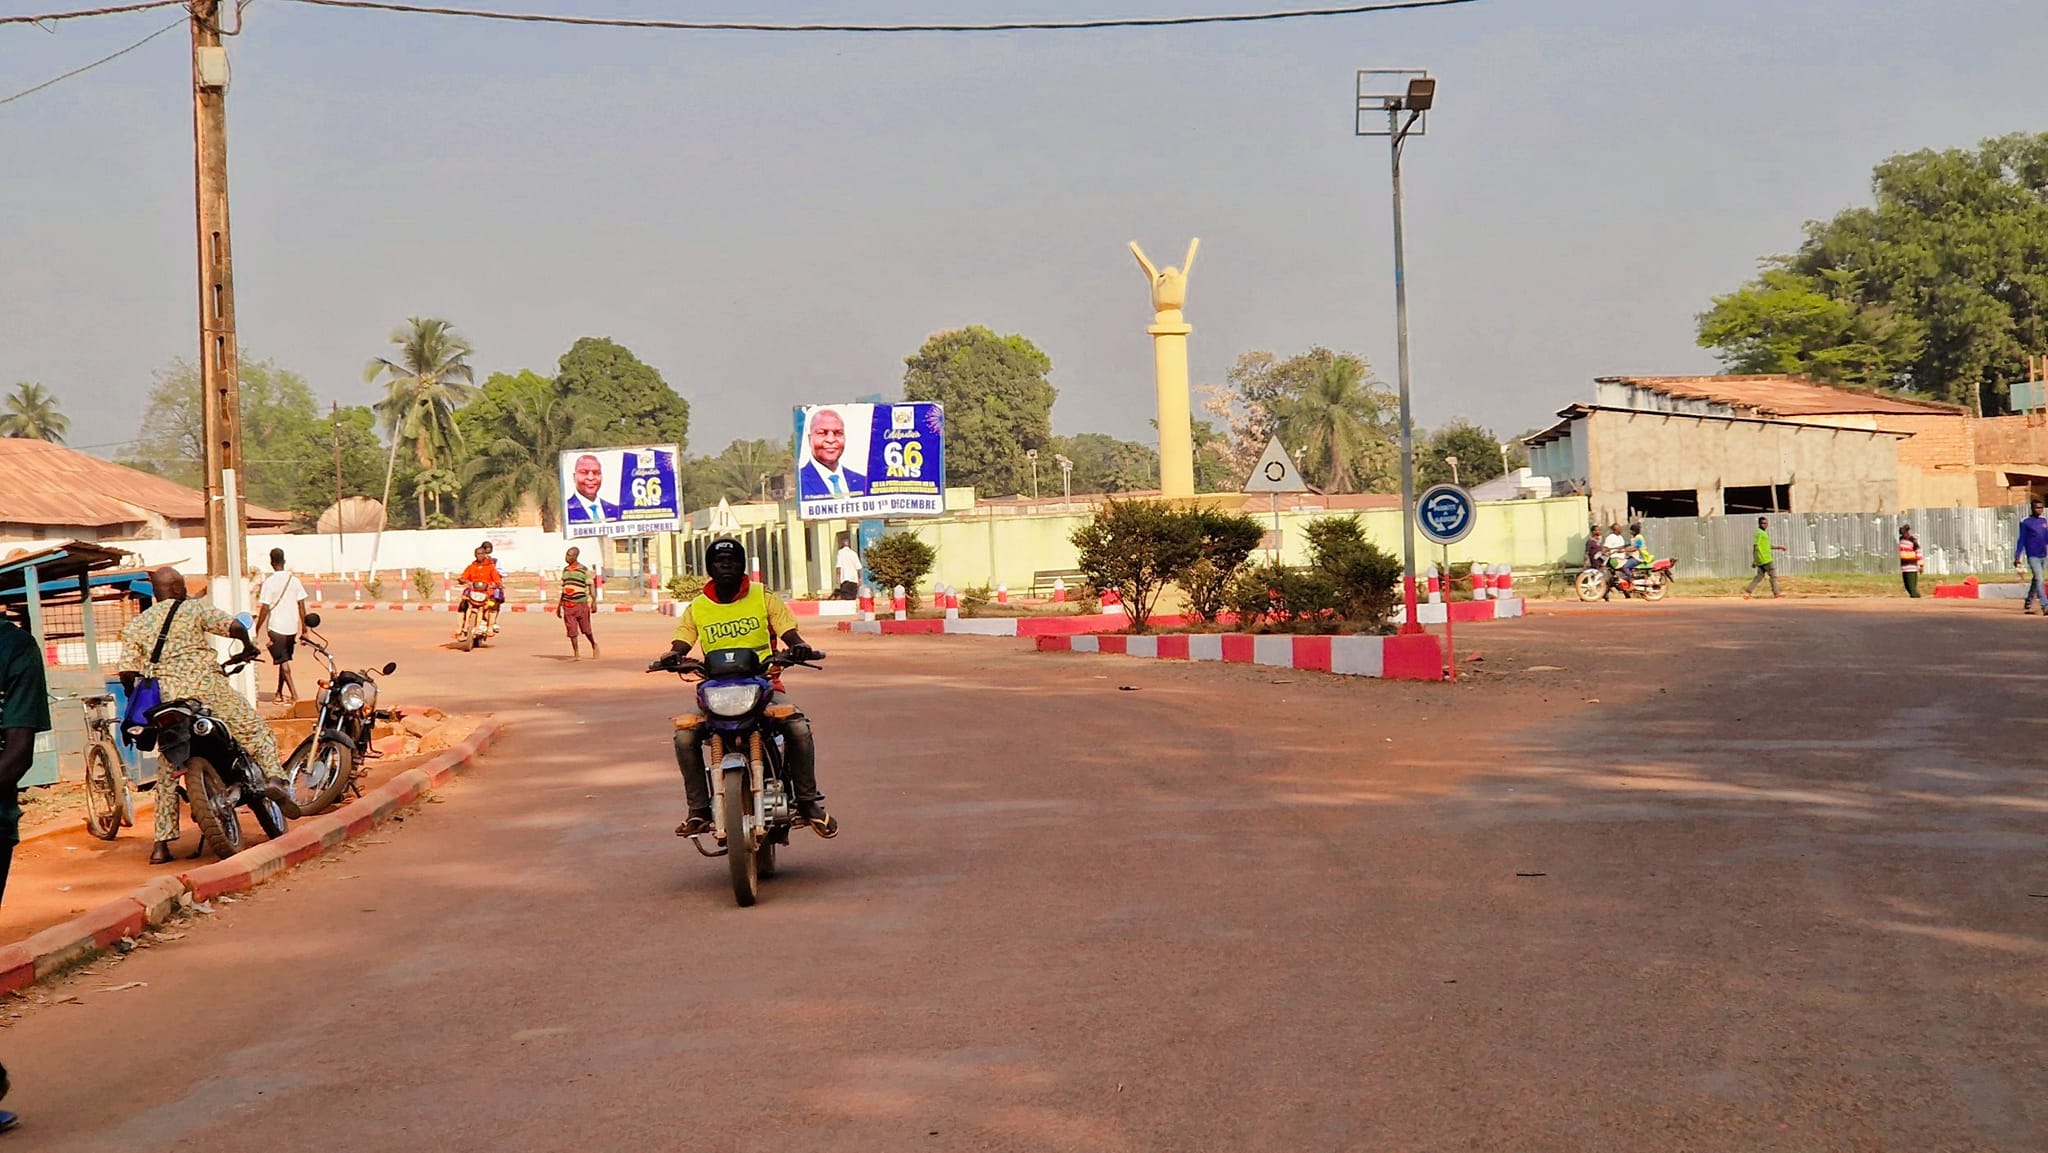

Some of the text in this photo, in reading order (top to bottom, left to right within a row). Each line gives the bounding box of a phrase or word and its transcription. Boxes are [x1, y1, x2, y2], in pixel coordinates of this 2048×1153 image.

[884, 441, 924, 468] 66
[886, 466, 921, 478] ANS
[631, 477, 662, 499] 66
[634, 497, 661, 507] ANS
[808, 503, 839, 516] BONNE
[841, 500, 860, 513] FÊTE
[863, 501, 875, 511] DU
[573, 527, 596, 536] BONNE
[615, 524, 625, 533] DU
